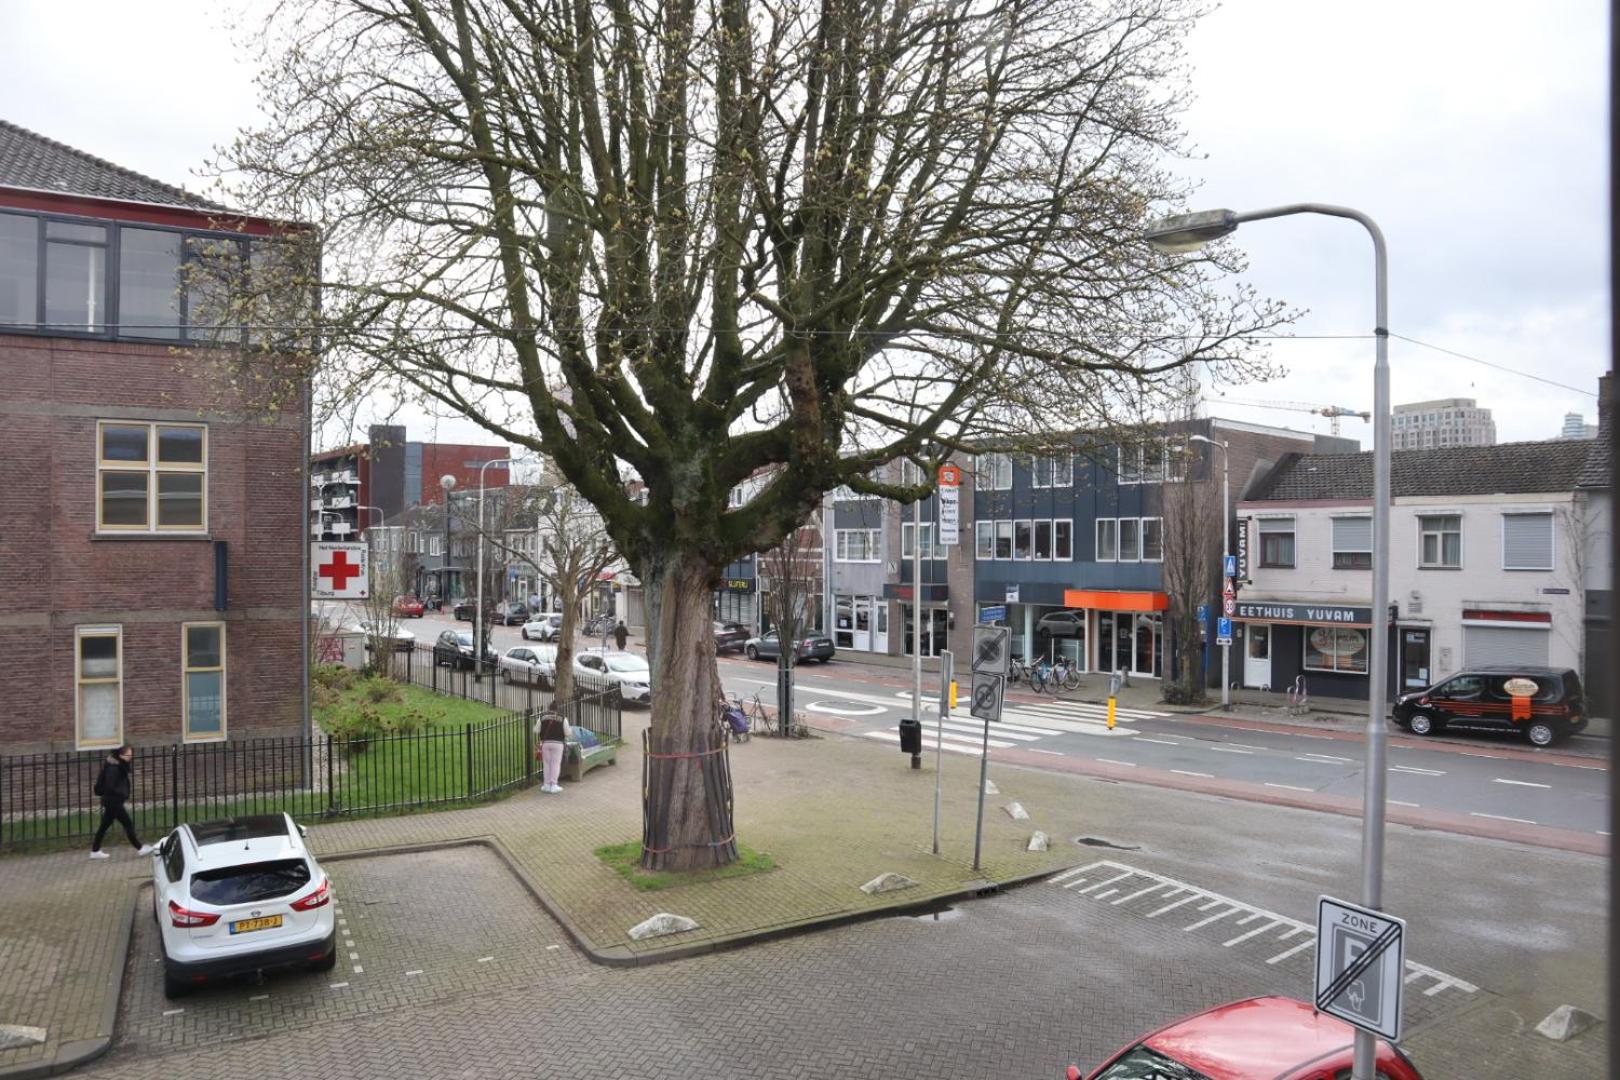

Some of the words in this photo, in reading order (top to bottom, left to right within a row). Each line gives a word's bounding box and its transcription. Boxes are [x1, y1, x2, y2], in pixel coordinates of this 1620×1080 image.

[1239, 605, 1295, 619] EETHUIS
[1307, 608, 1355, 622] YUVAM
[1342, 913, 1377, 933] ZONE
